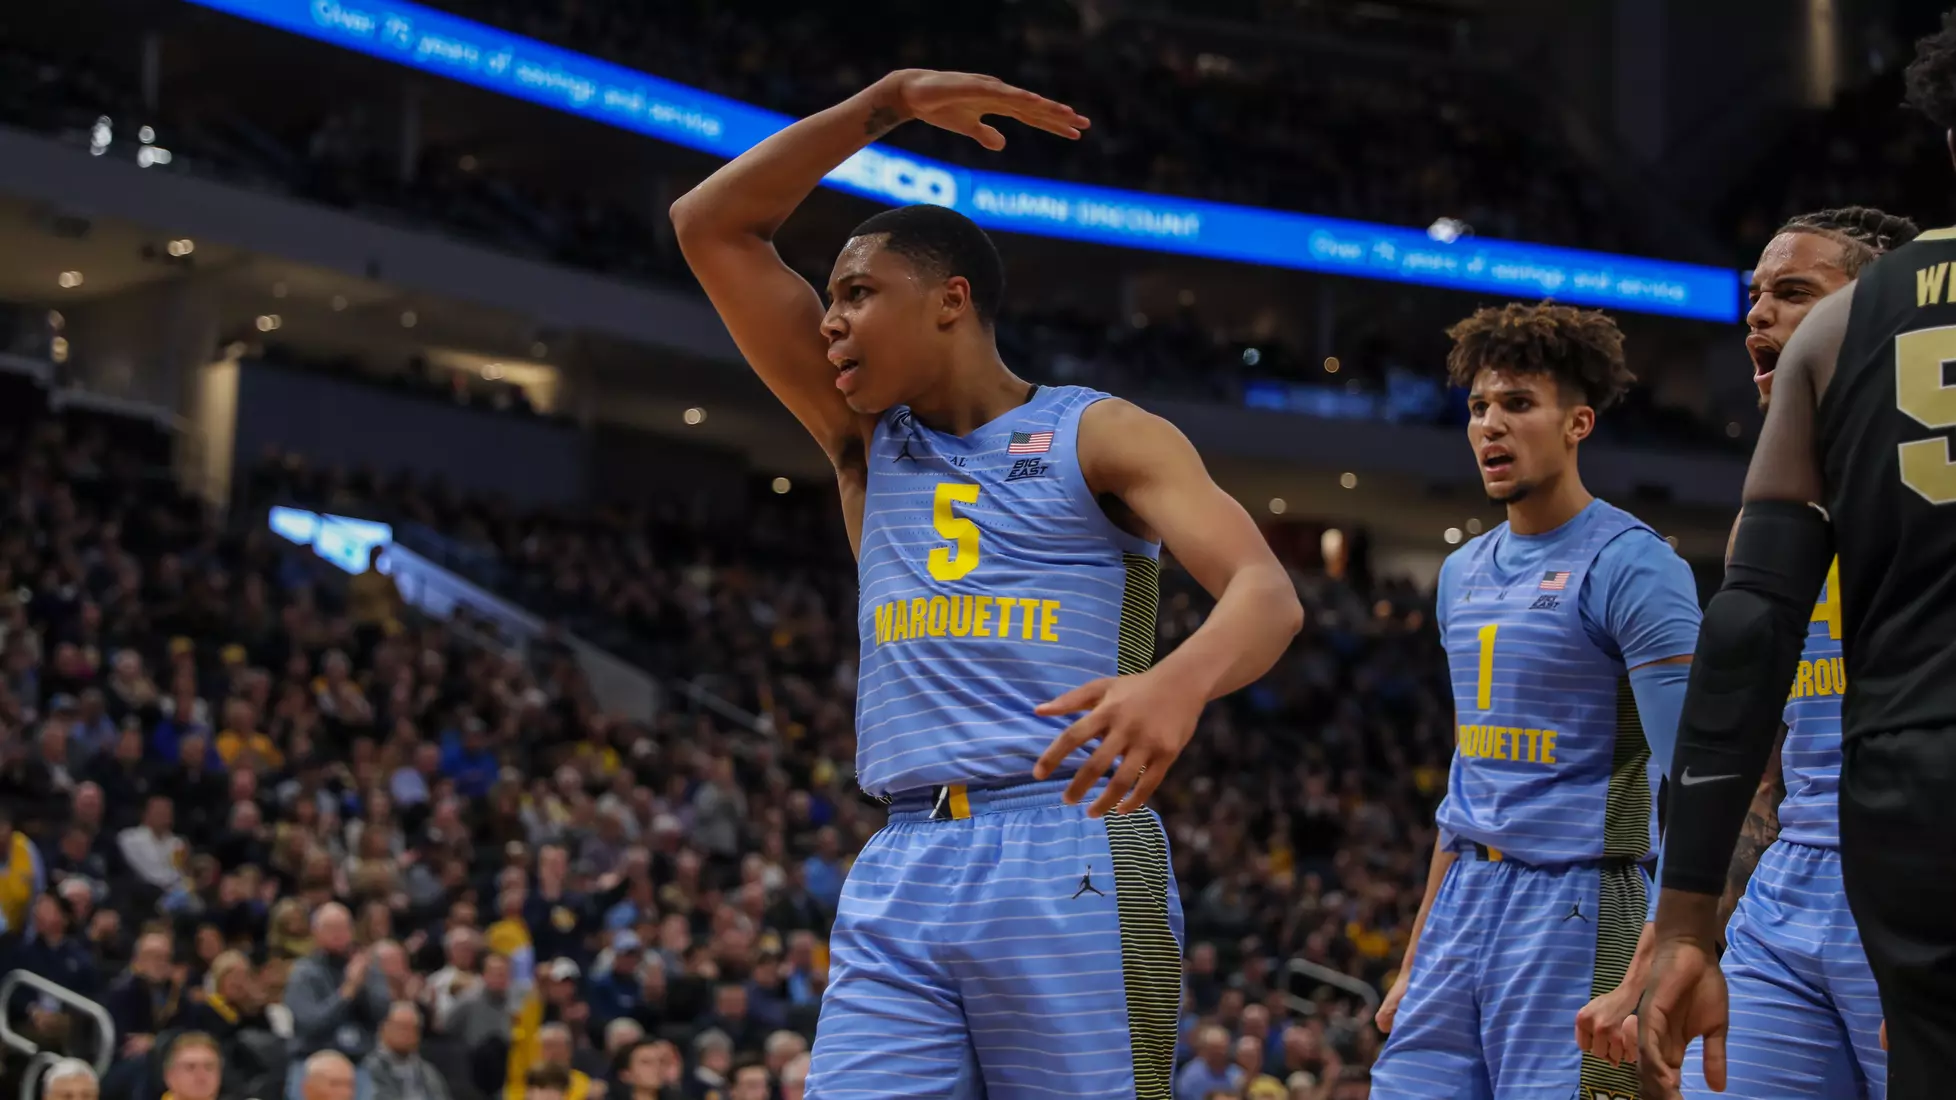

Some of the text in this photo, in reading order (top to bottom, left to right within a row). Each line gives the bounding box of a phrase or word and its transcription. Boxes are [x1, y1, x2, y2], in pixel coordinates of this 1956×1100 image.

[1008, 466, 1048, 478] EAST
[1012, 457, 1042, 469] BIG
[927, 483, 980, 581] 5
[875, 595, 1061, 646] MARQUETTE
[1477, 624, 1498, 710] 1
